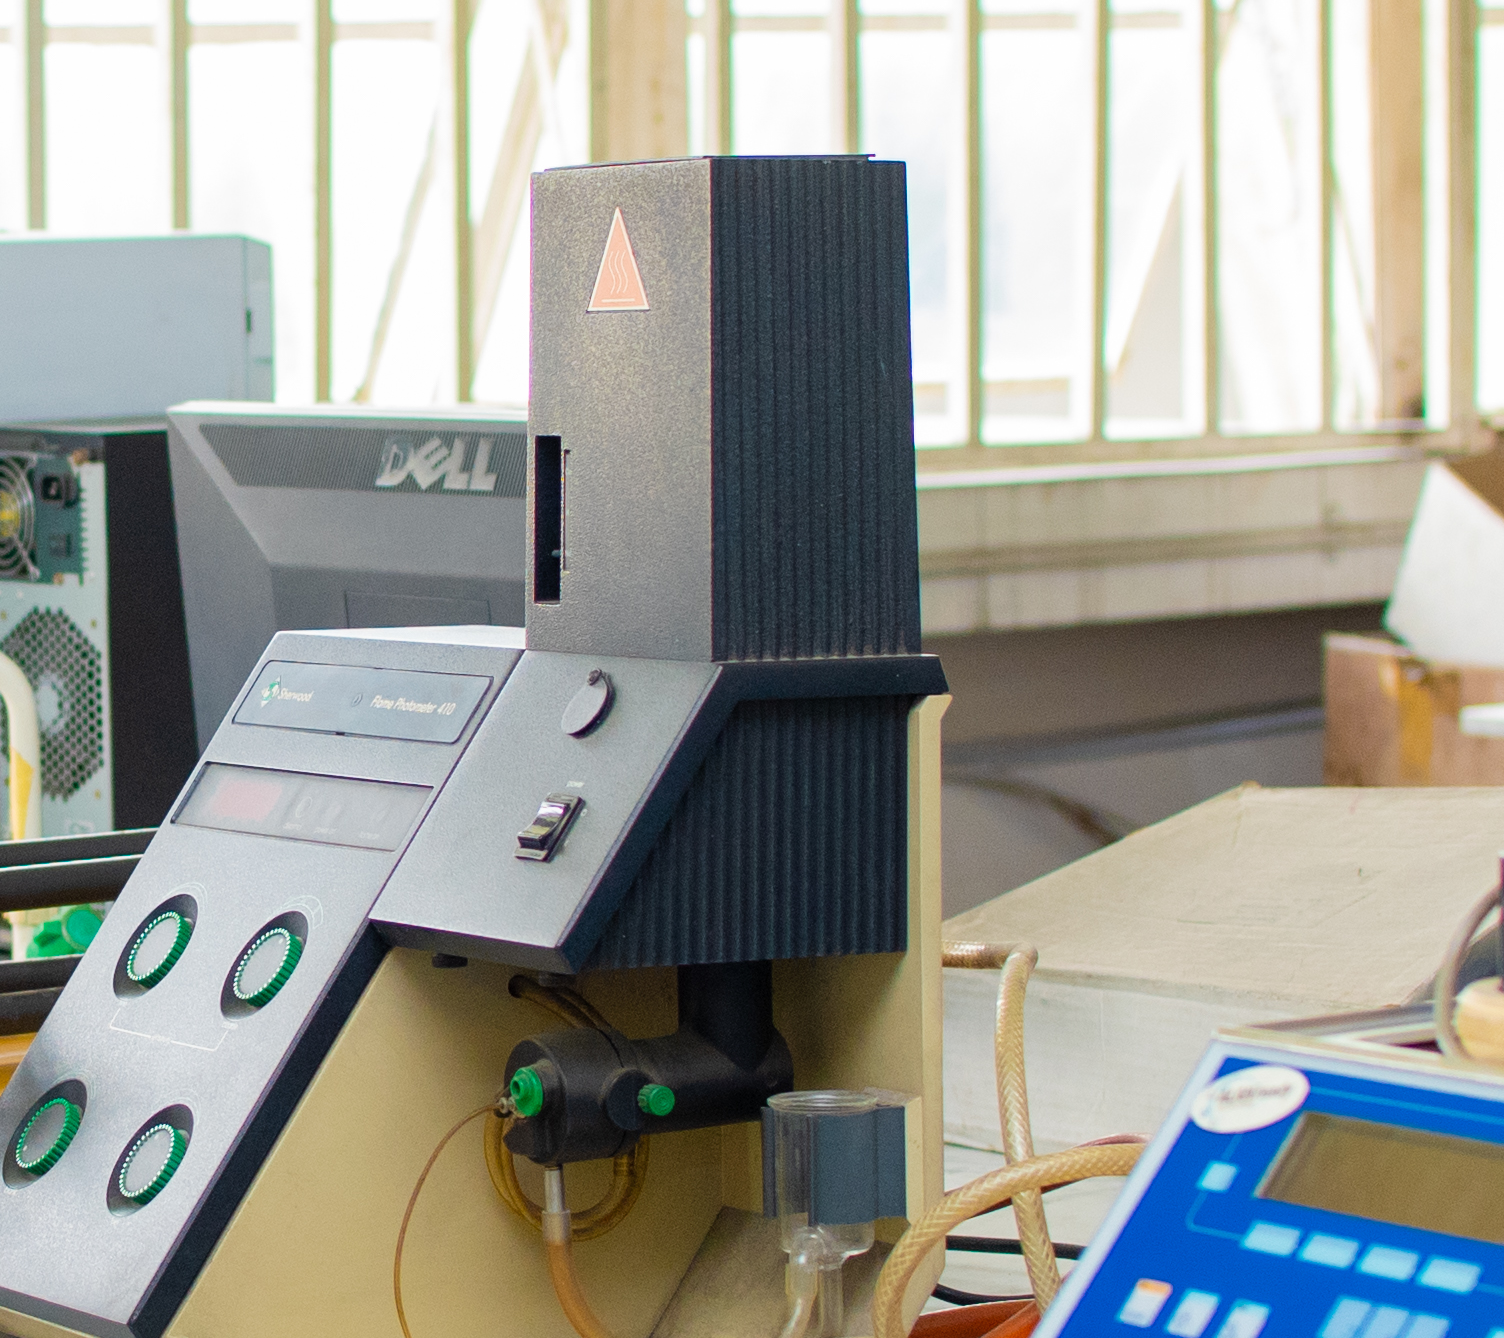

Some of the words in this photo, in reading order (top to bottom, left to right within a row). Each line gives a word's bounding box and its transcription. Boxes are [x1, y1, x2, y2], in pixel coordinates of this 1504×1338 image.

[374, 435, 499, 491] DELL
[277, 686, 315, 703] Sherwood
[370, 693, 394, 710] Flame
[392, 696, 438, 715] Photometer
[437, 702, 457, 716] 410
